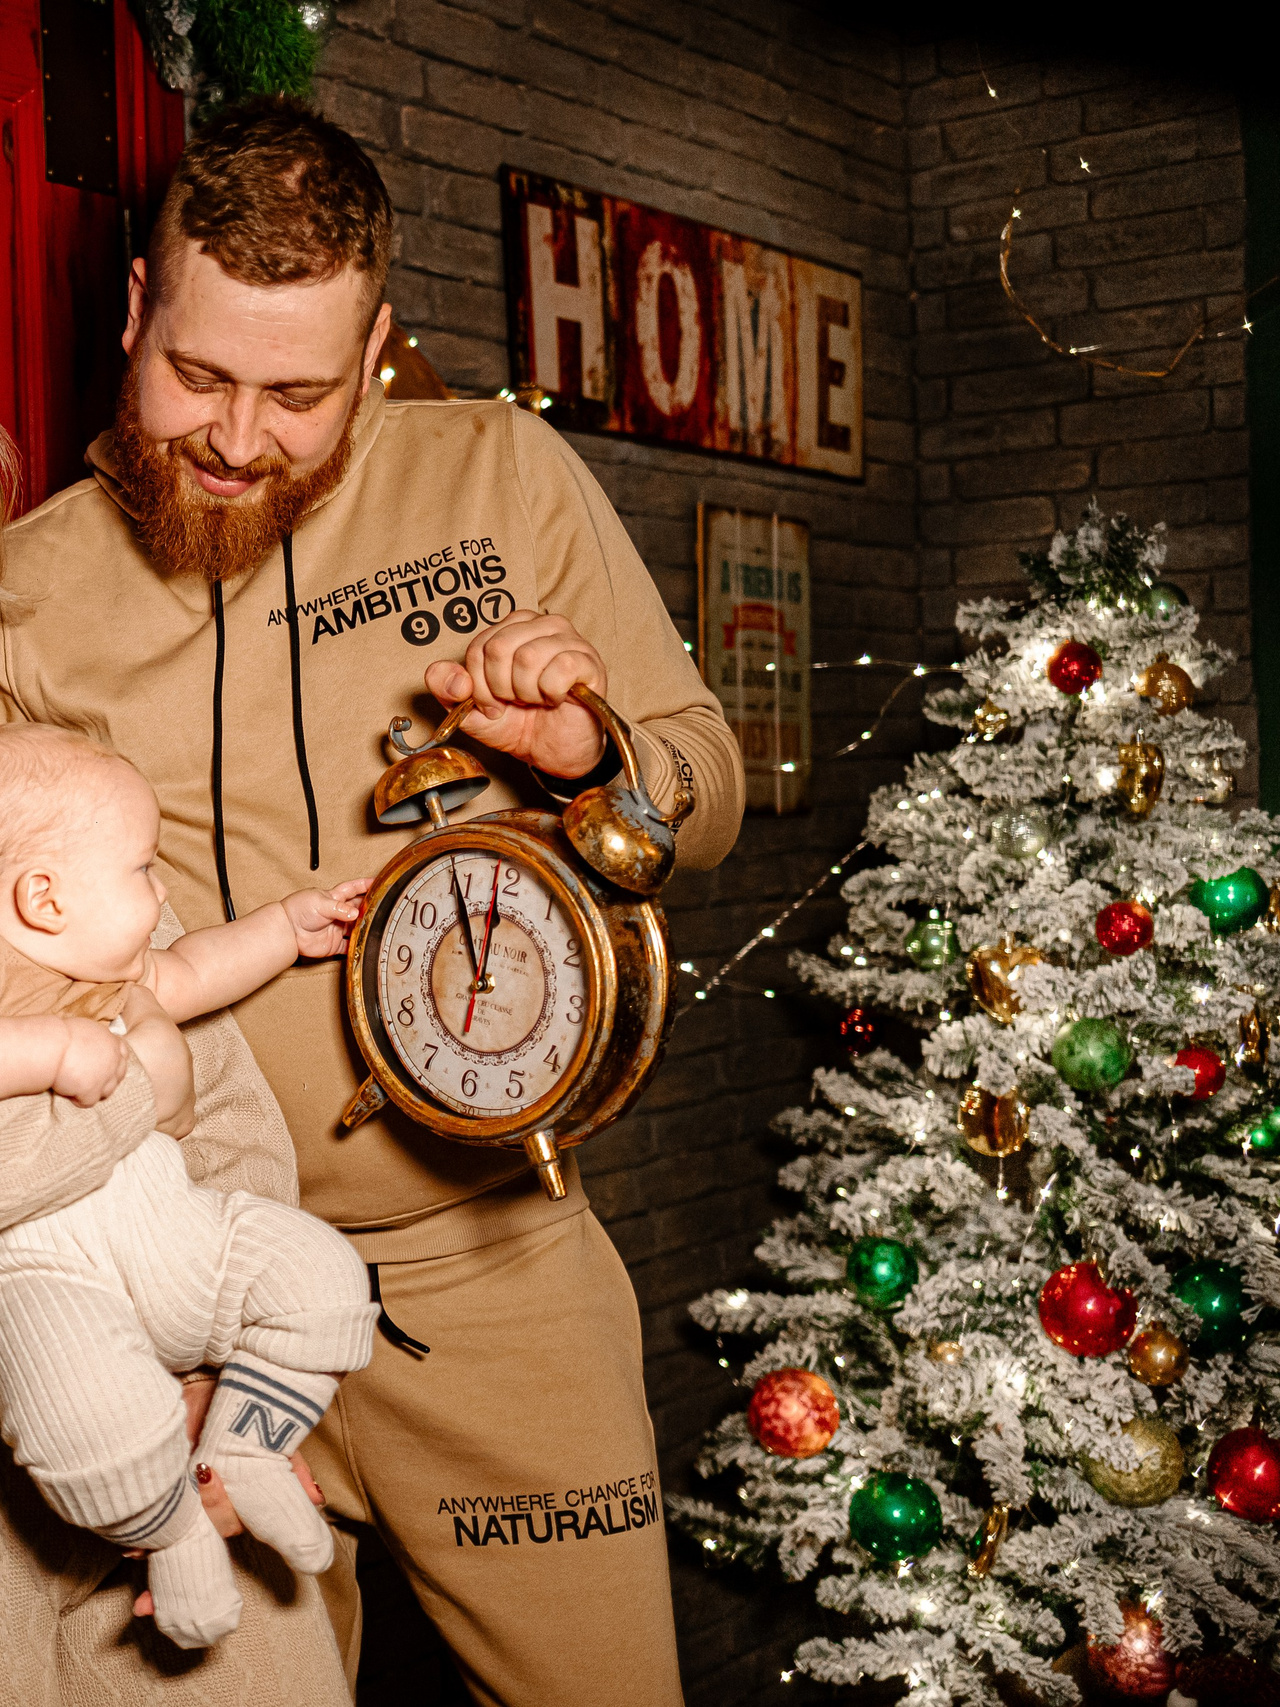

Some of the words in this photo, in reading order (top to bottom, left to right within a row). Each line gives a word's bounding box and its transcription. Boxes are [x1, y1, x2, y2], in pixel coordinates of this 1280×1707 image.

[526, 202, 852, 455] HOME
[374, 546, 455, 586] CHANCE
[459, 537, 495, 557] FOR
[311, 555, 507, 645] AMBITIONS
[409, 899, 437, 930] 10
[395, 944, 412, 975] 9
[503, 946, 528, 964] NOIR
[563, 938, 581, 969] 2
[397, 994, 415, 1028] 8
[566, 994, 584, 1025] 3
[422, 1043, 439, 1070] 7
[543, 1045, 562, 1073] 4
[461, 1069, 479, 1097] 6
[505, 1070, 526, 1099] 5
[437, 1492, 557, 1515] ANYWHERE
[565, 1477, 637, 1508] CHANCE
[453, 1490, 660, 1547] NATURALISM
